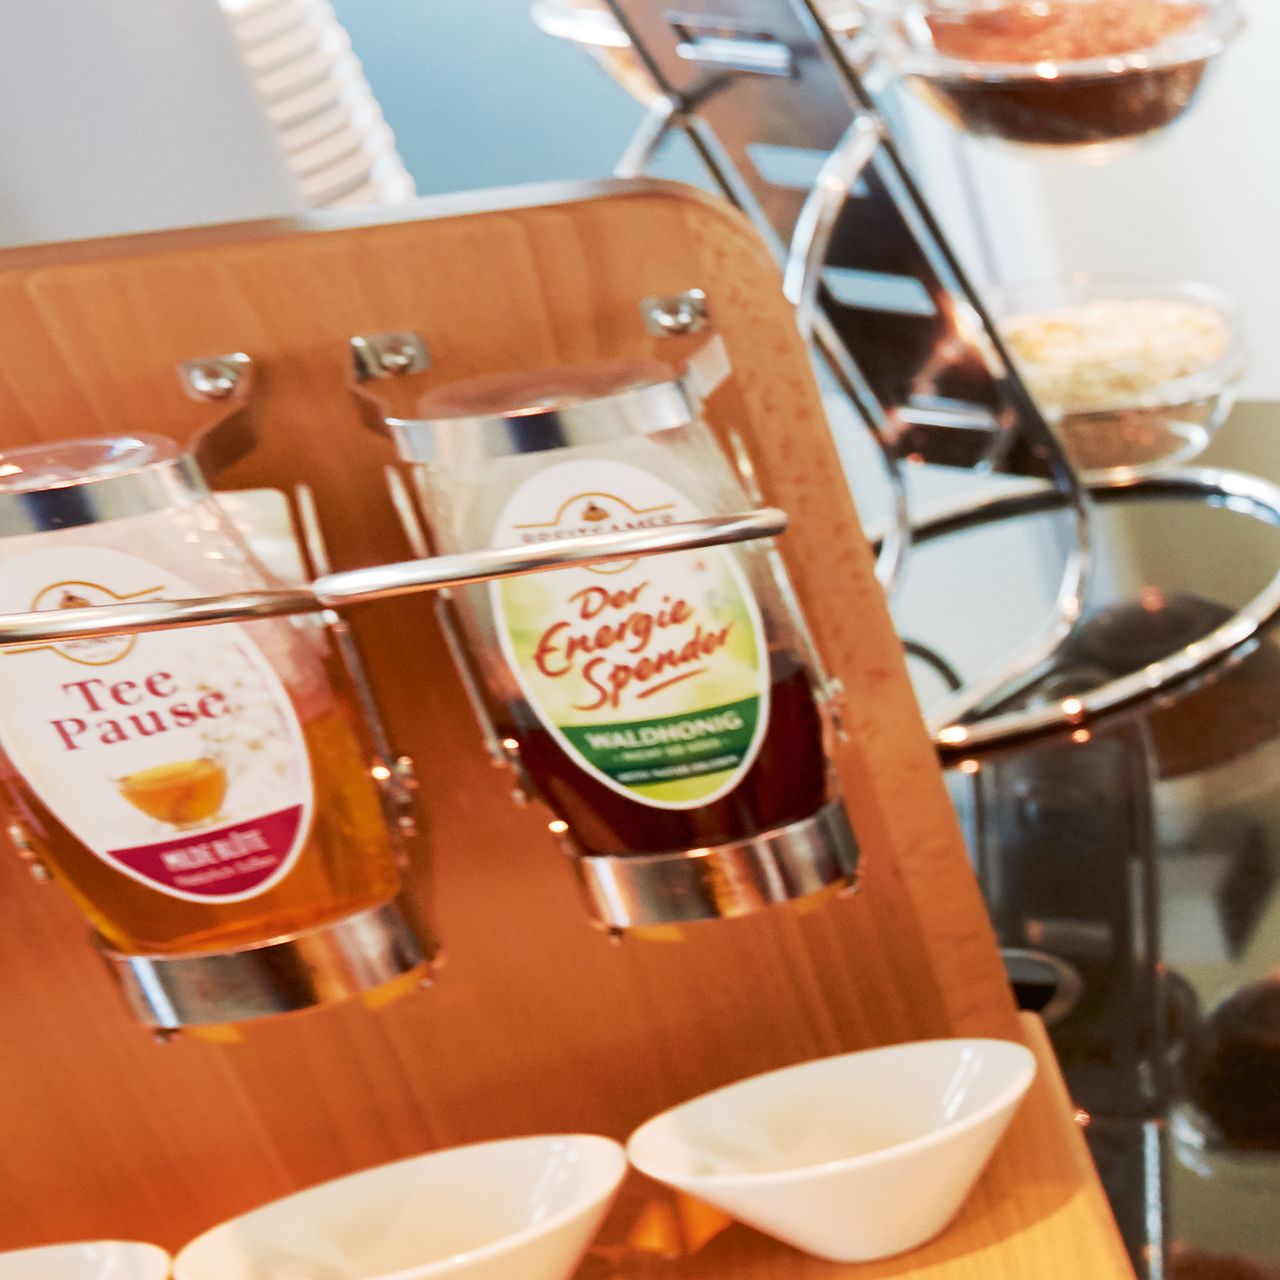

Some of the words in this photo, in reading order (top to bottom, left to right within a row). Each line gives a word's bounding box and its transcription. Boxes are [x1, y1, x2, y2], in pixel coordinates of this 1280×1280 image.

[568, 580, 651, 621] Der
[533, 596, 695, 678] Energie
[571, 622, 736, 712] Spender
[49, 690, 232, 752] Pause
[61, 670, 181, 713] Tee
